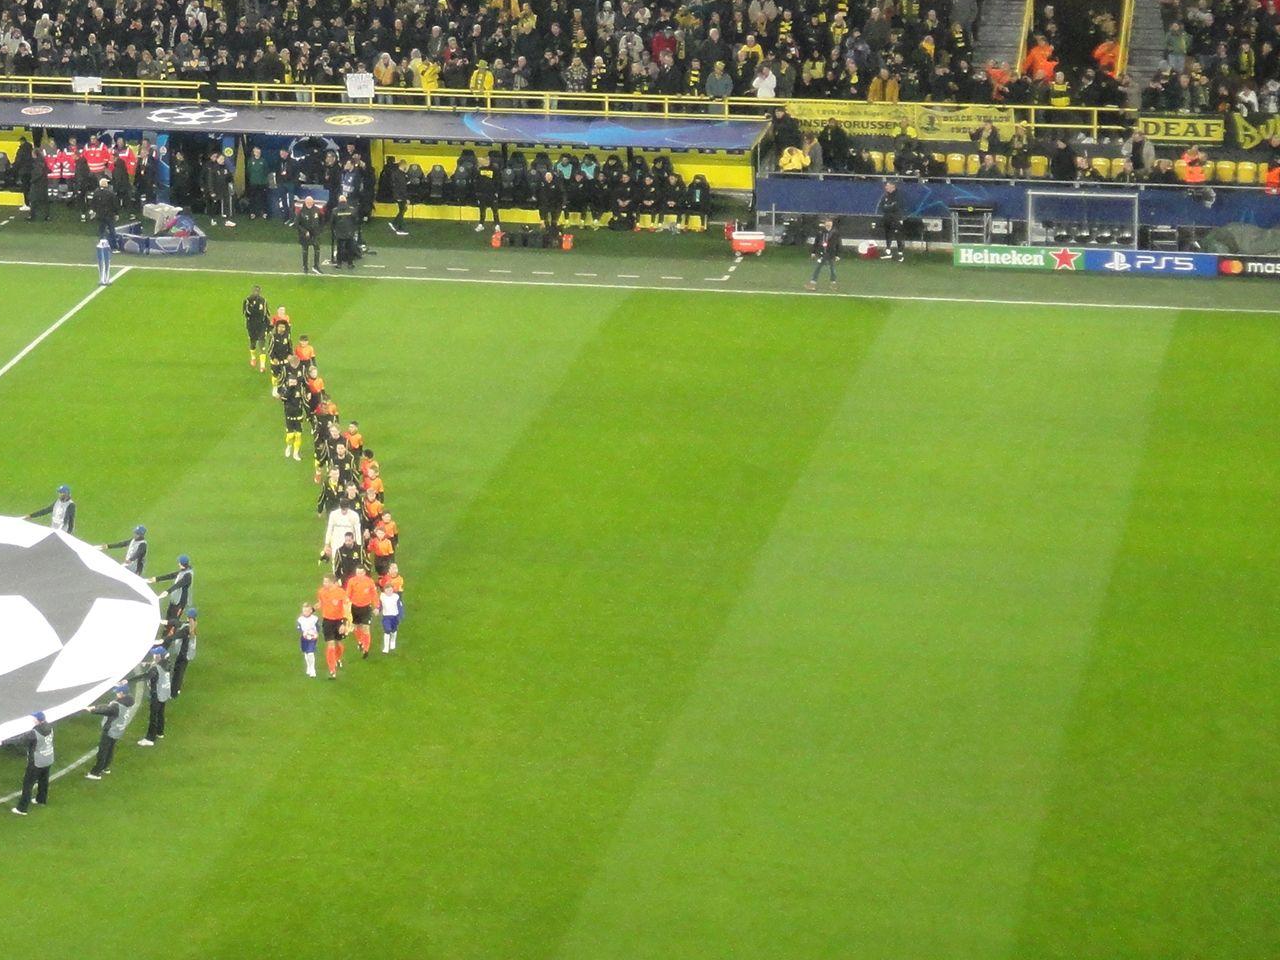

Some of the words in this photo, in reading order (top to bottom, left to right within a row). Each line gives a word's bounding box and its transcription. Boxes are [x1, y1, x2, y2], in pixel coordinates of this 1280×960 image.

[1142, 120, 1222, 138] DEAF
[959, 248, 1044, 265] Heineken
[1136, 257, 1194, 271] PS5
